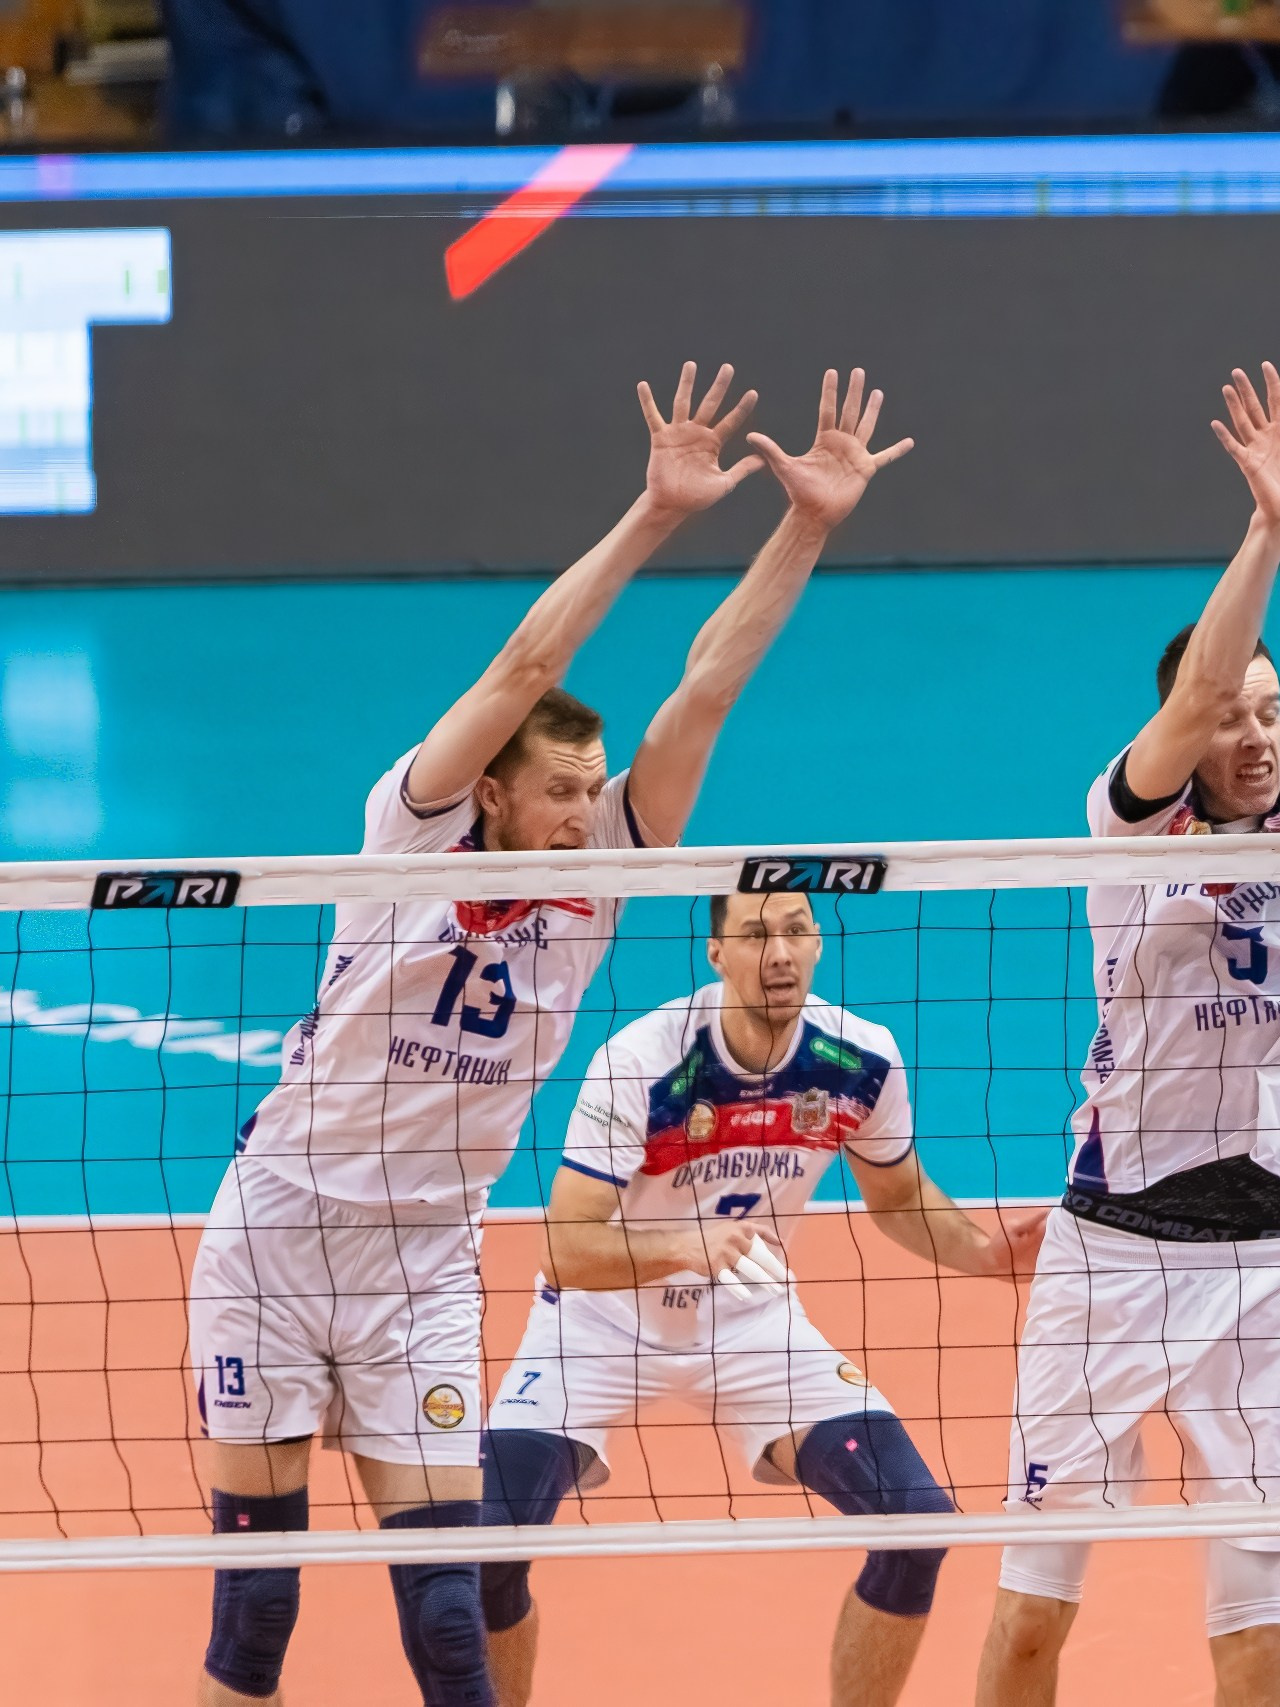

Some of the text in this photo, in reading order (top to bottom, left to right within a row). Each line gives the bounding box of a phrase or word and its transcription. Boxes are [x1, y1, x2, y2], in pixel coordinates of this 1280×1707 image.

[104, 877, 228, 906] PARI
[752, 861, 875, 890] PARI
[431, 945, 518, 1039] 13
[1096, 1204, 1240, 1242] COMBAT
[214, 1355, 246, 1396] 13
[516, 1371, 541, 1395] 7
[1025, 1462, 1048, 1496] 5
